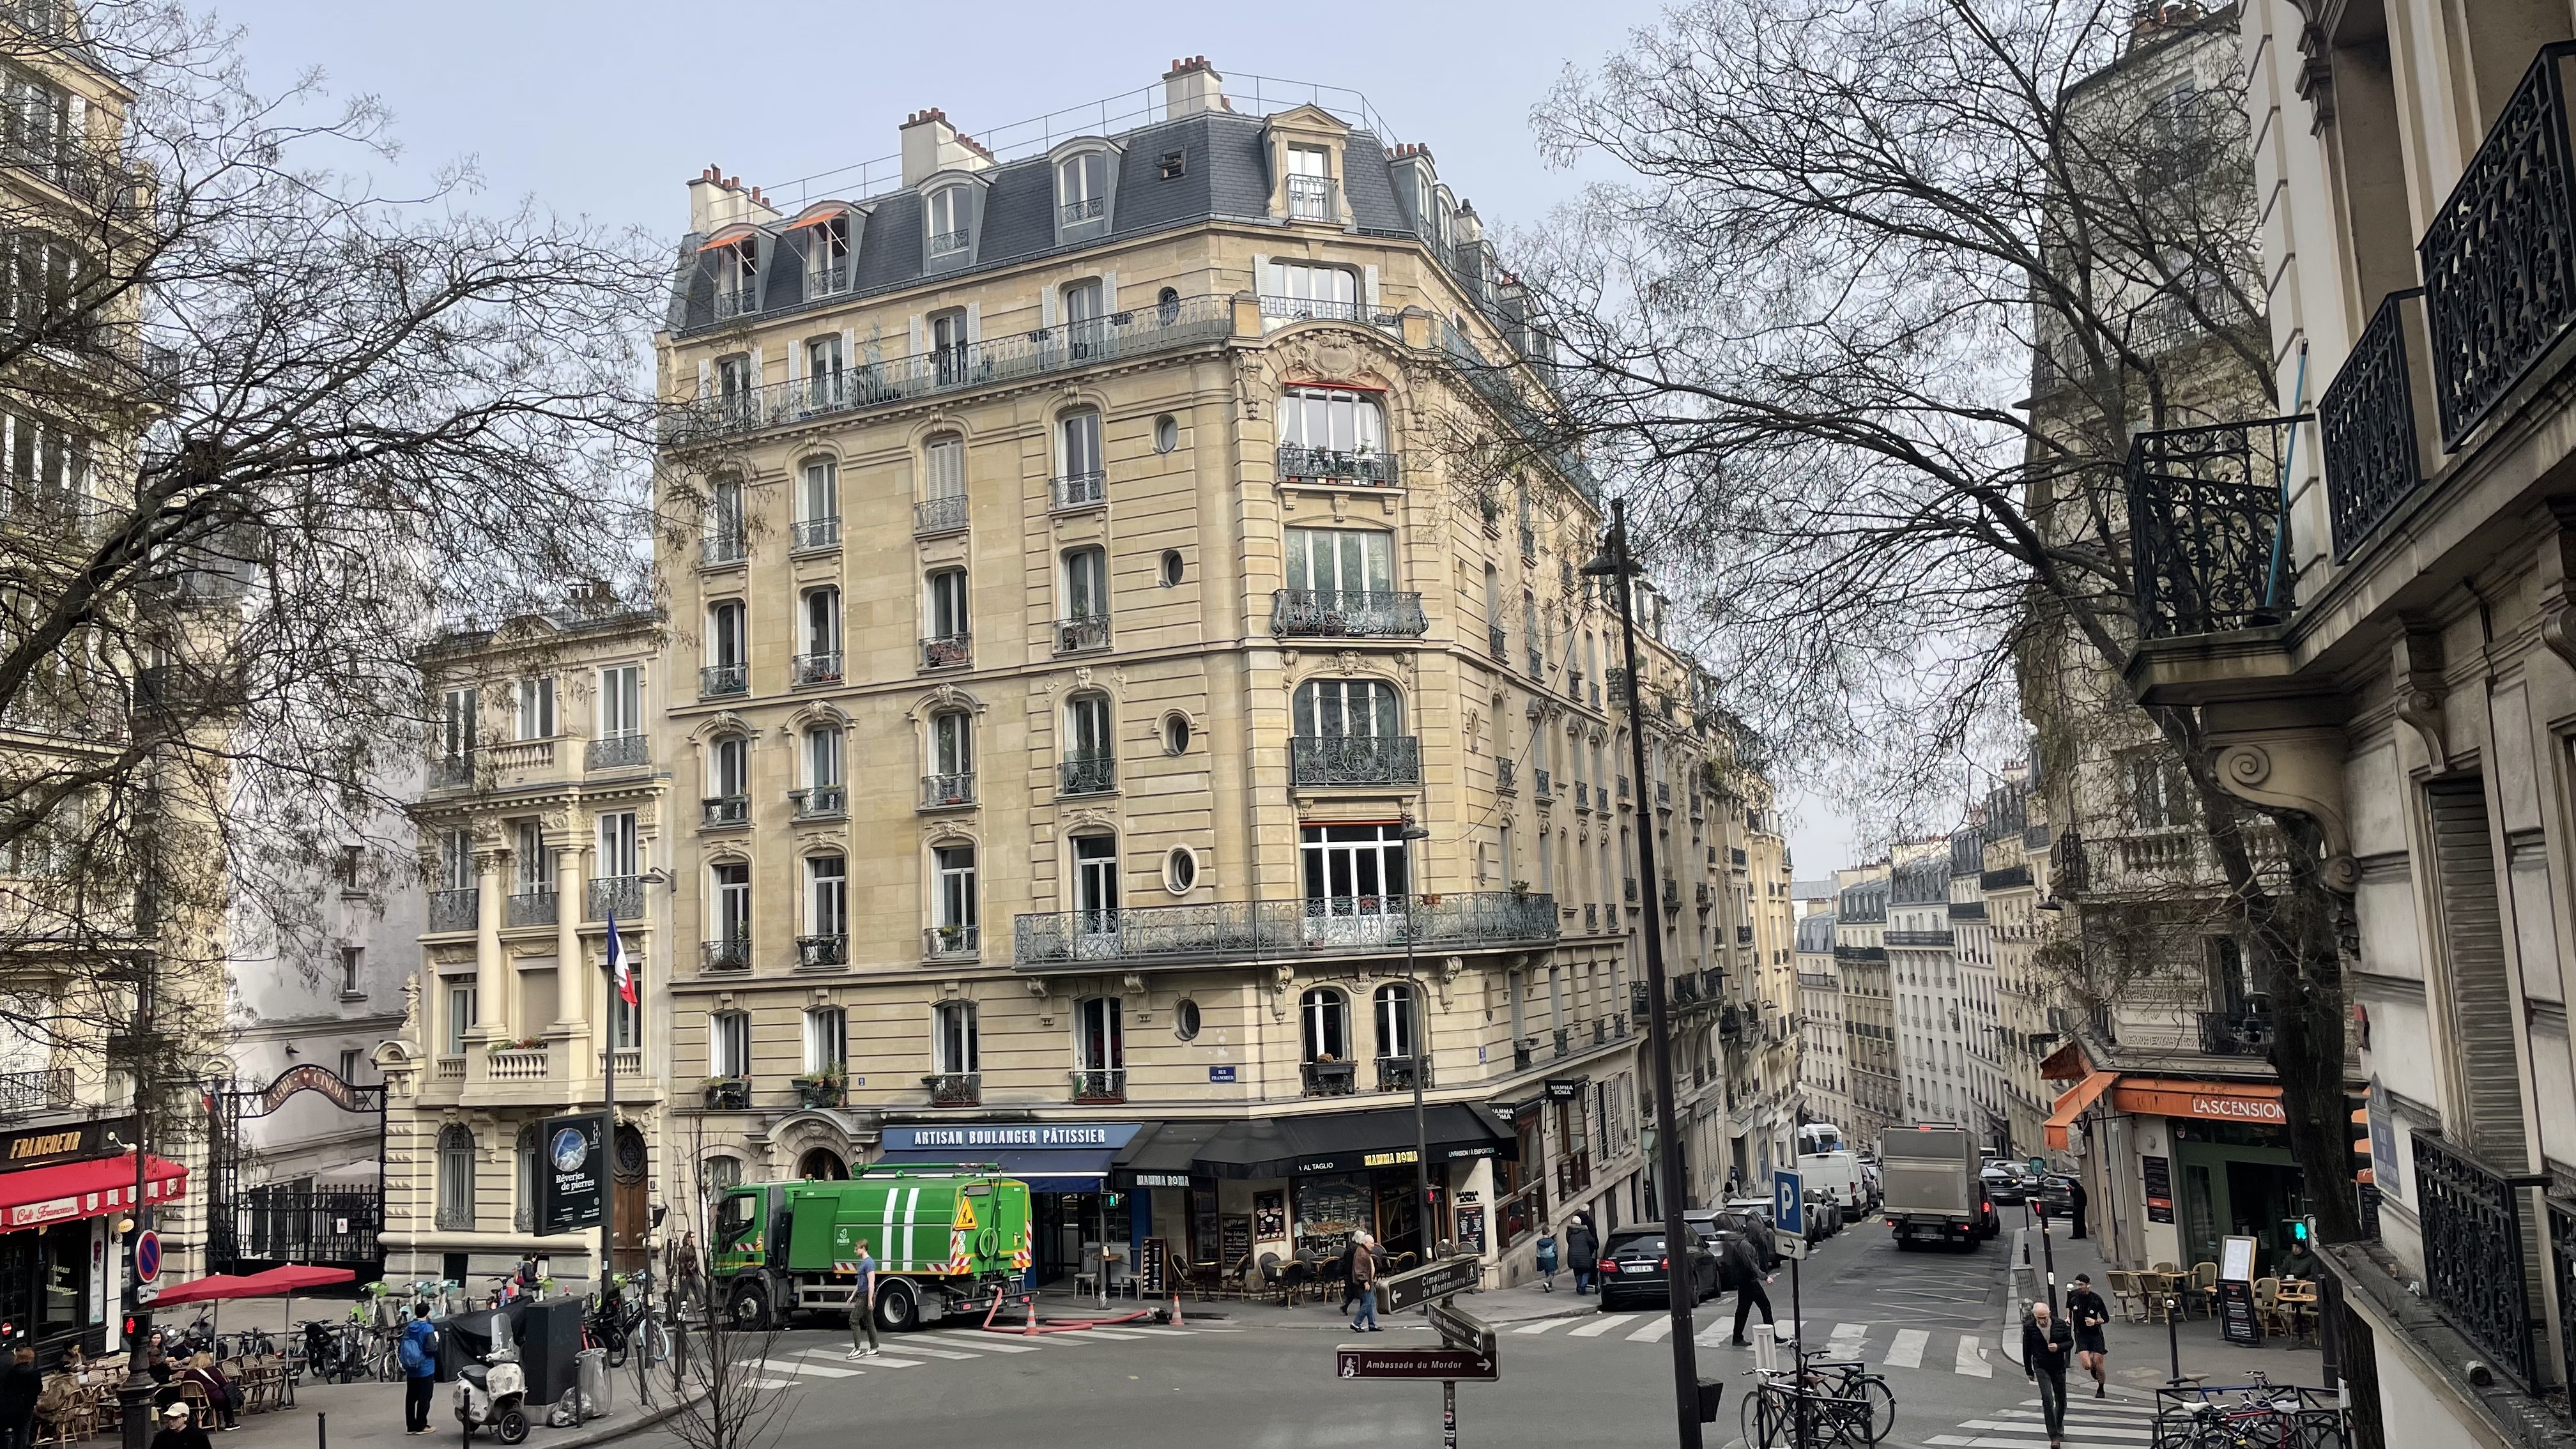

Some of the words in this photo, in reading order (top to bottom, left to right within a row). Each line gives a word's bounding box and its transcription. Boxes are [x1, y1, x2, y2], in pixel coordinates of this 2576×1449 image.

[914, 1130, 963, 1146] ARTISAN
[969, 1130, 1036, 1144] BOULANGER
[1043, 1127, 1105, 1144] PÂTISSIER
[8, 1131, 82, 1160] FRANCOEUR
[1364, 1153, 1395, 1166] MAMMA
[1395, 1151, 1418, 1165] ROMA
[556, 1172, 585, 1183] Rêveries
[561, 1182, 570, 1190] de
[571, 1179, 595, 1191] pierres
[1137, 1175, 1166, 1186] MAMMA
[1167, 1175, 1189, 1186] ROMA
[1781, 1181, 1793, 1220] P
[1422, 1271, 1451, 1286] Cimetière
[1422, 1288, 1430, 1298] de
[1432, 1277, 1466, 1295] Montmartre
[1443, 1317, 1466, 1338] Montmartre
[1366, 1360, 1413, 1368] Ambassade
[1417, 1360, 1427, 1368] du
[1431, 1360, 1462, 1368] Mordor
